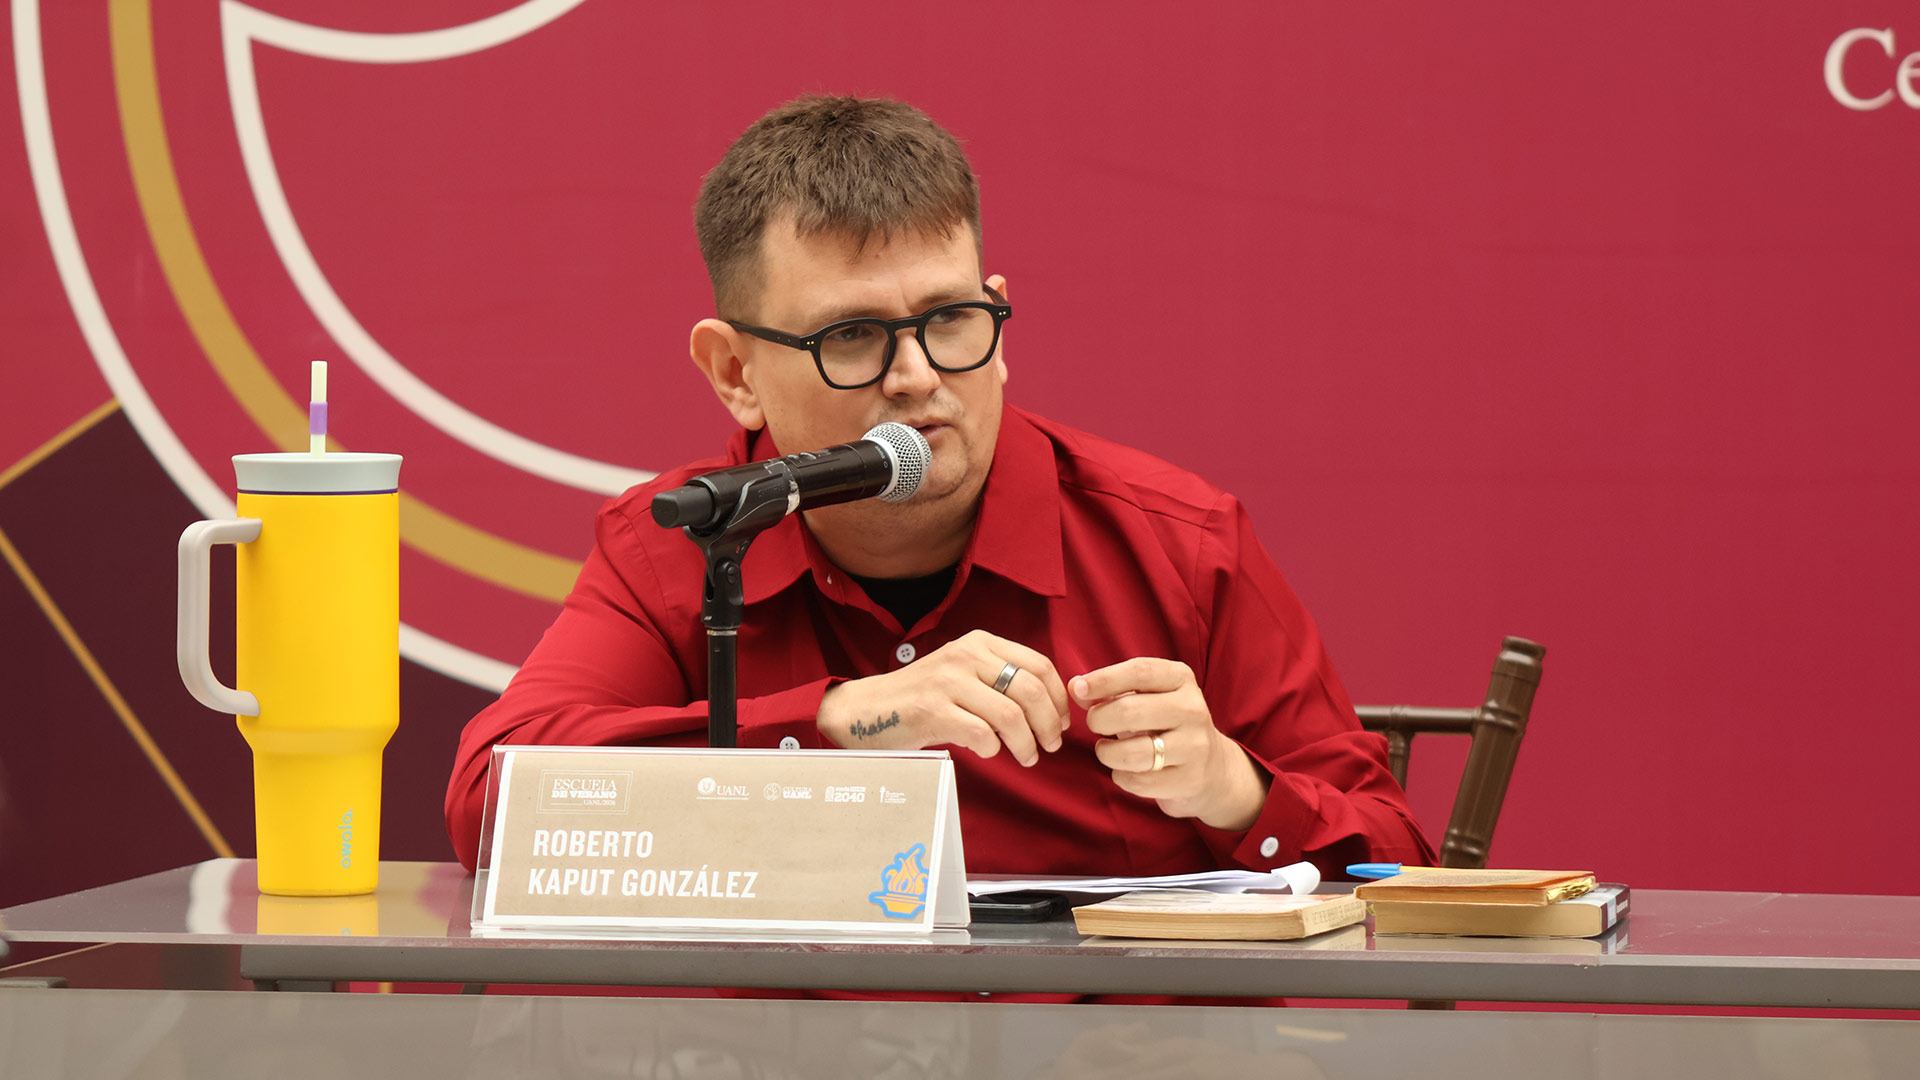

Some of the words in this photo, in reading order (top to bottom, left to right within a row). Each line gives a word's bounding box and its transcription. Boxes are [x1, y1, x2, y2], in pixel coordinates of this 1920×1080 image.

[553, 778, 617, 791] ESCUELA
[551, 790, 568, 799] DE
[570, 790, 617, 799] VERANO
[717, 785, 750, 796] UANL
[783, 791, 812, 799] UANL
[834, 792, 865, 803] 2040
[532, 829, 654, 858] ROBERTO
[528, 868, 615, 896] KAPUT
[621, 864, 758, 898] GONZÁLEZ
